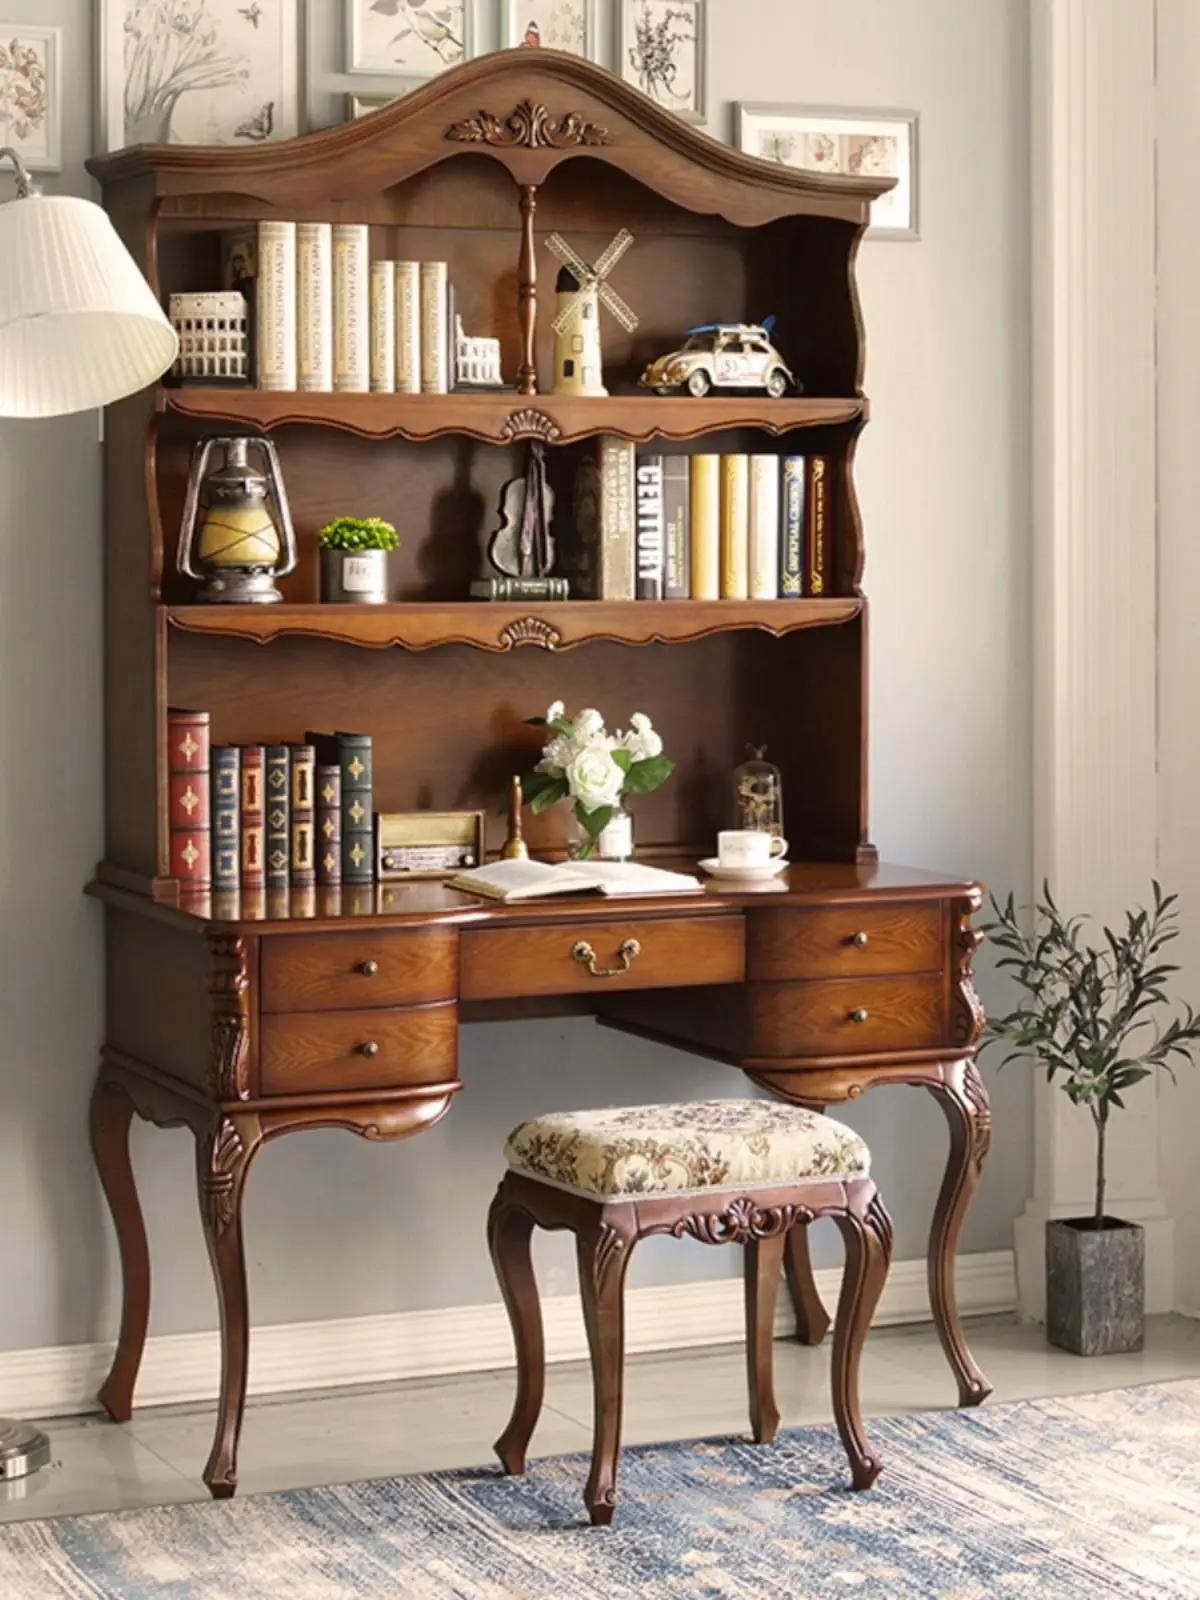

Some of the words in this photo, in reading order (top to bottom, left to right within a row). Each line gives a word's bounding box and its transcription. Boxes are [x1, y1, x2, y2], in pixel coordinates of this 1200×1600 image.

[275, 243, 285, 275] NEW
[312, 243, 322, 276] NEW
[348, 243, 357, 276] NEW
[275, 331, 285, 371] CONN
[312, 331, 322, 371] CONN
[348, 331, 357, 371] CONN
[637, 465, 662, 581] CENTURY
